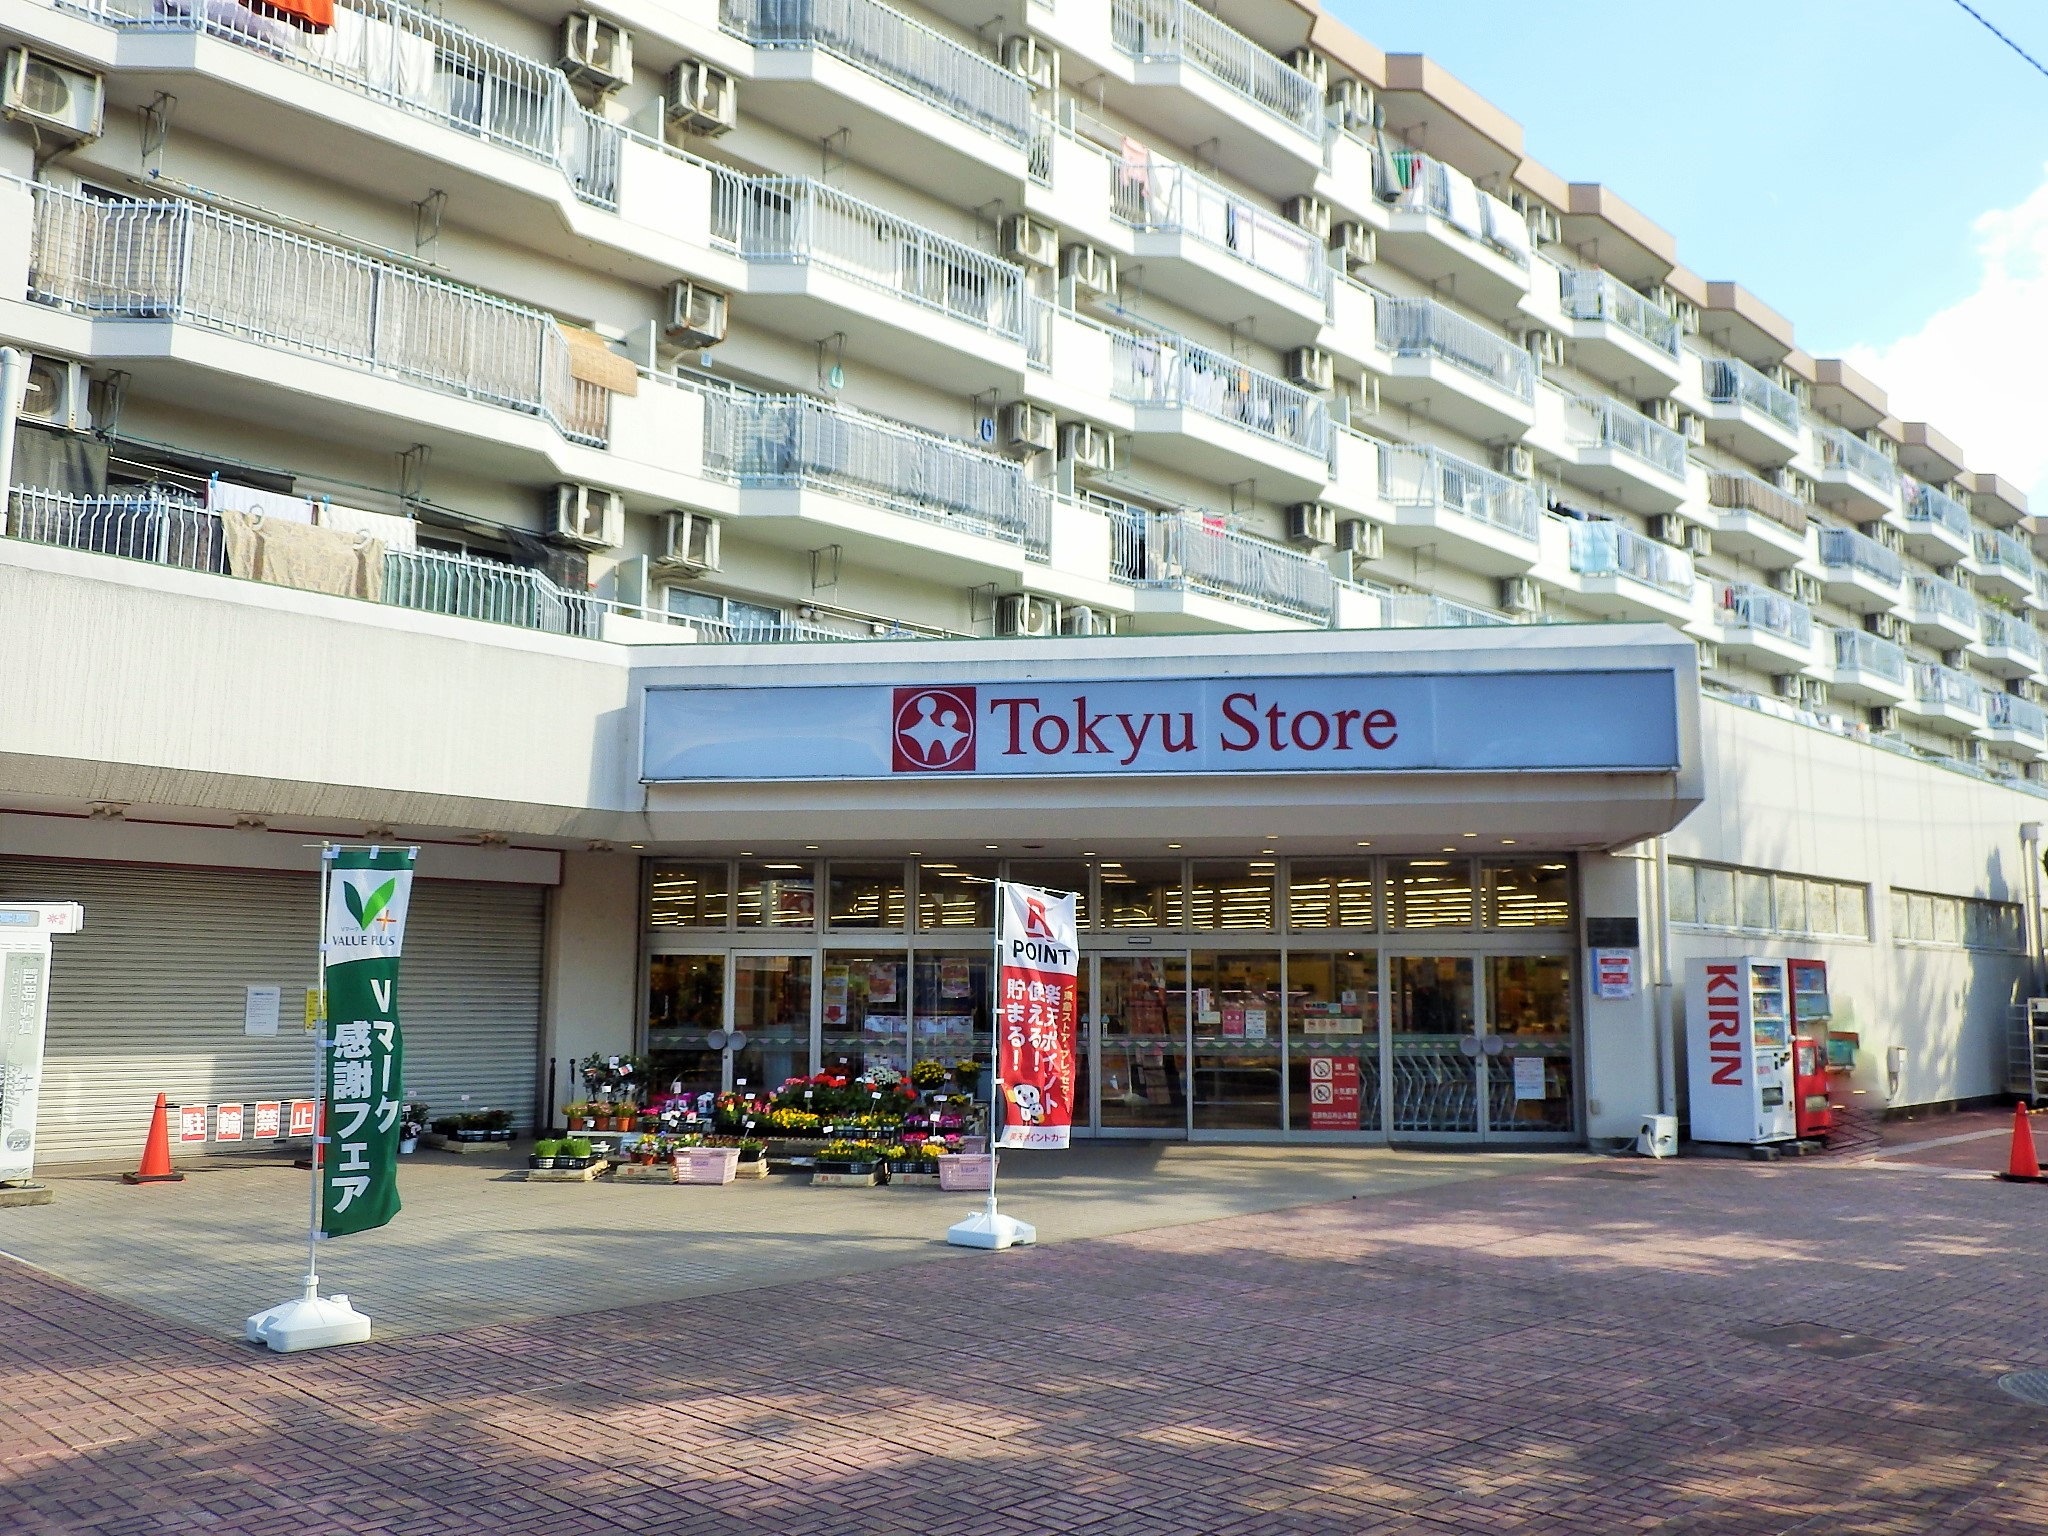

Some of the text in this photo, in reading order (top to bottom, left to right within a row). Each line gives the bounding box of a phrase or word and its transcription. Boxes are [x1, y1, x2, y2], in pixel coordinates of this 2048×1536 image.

[990, 693, 1398, 765] Tokyu Store
[332, 935, 396, 946] VALUE PLUS
[1013, 939, 1070, 965] POINT
[18, 967, 39, 1036] 証明写真
[1006, 978, 1026, 1071] 貯まる！
[1027, 980, 1045, 1072] 使える！
[1706, 965, 1743, 1085] KIRIN
[370, 979, 400, 1133] Vマーク
[1041, 985, 1061, 1115] 楽天ポイント
[182, 1106, 313, 1135] 駐輪禁止
[332, 1020, 373, 1213] 感謝フェア
